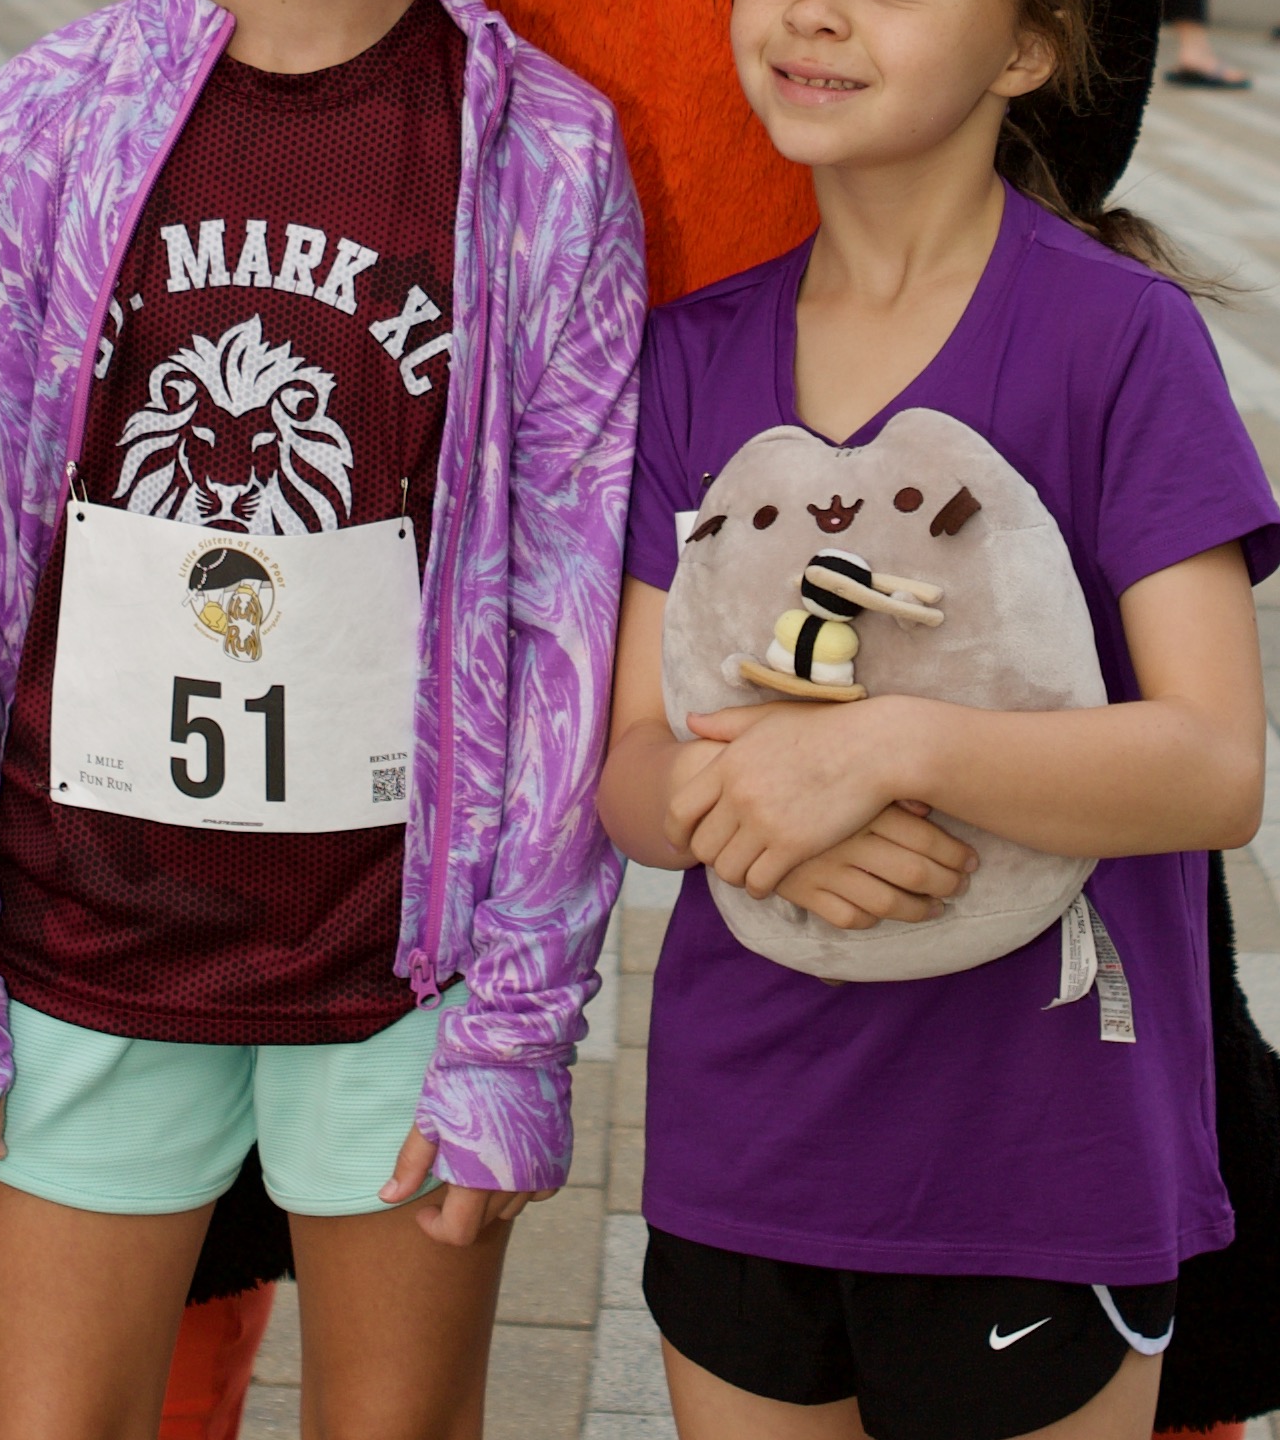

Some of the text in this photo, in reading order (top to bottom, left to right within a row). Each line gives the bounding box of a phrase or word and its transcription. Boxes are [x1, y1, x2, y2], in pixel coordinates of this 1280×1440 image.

[160, 218, 454, 396] MARK XC
[178, 536, 286, 588] Little Sisters of the Poor
[95, 755, 124, 770] MILE
[170, 676, 286, 803] 51
[369, 751, 407, 763] RESULTS
